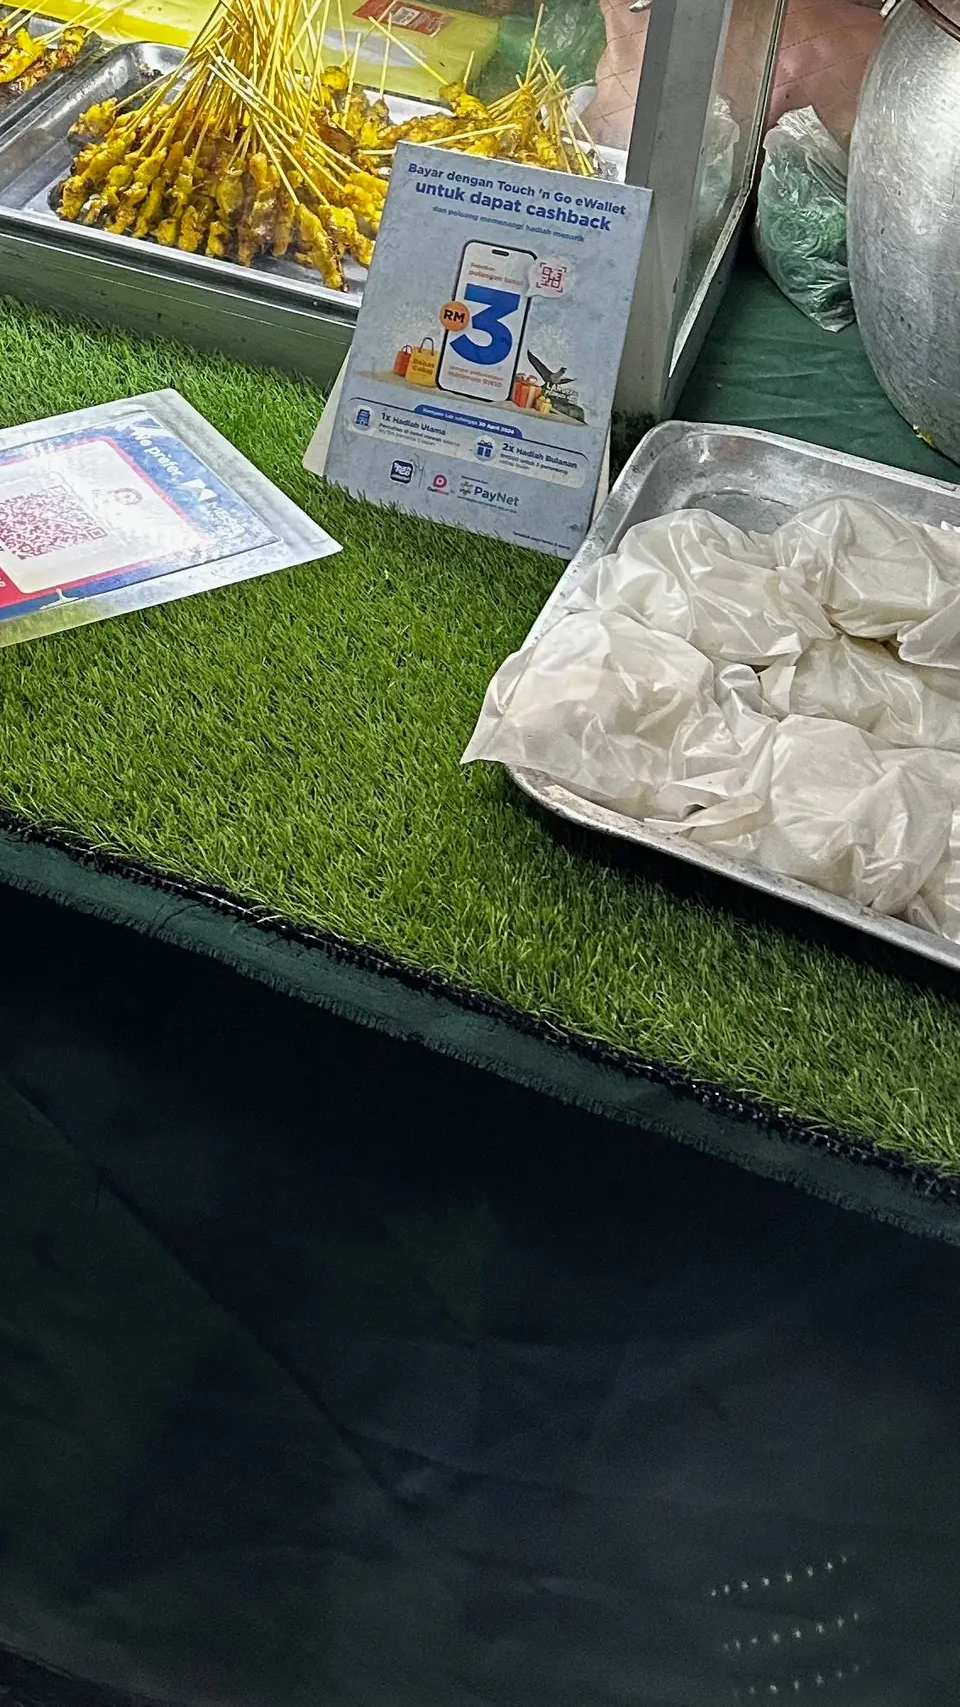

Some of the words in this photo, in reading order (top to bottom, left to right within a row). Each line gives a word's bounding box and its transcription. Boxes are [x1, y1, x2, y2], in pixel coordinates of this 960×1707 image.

[408, 163, 444, 178] Bayar
[447, 171, 493, 188] dengan
[498, 180, 535, 197] Touch
[554, 192, 571, 204] Go
[575, 197, 626, 215] eWallet
[416, 181, 465, 202] untuk
[470, 191, 521, 213] dapat
[526, 204, 611, 231] cashback
[443, 309, 465, 323] RM
[449, 283, 521, 365] 3
[502, 443, 514, 454] 2x
[474, 485, 519, 507] PayNet
